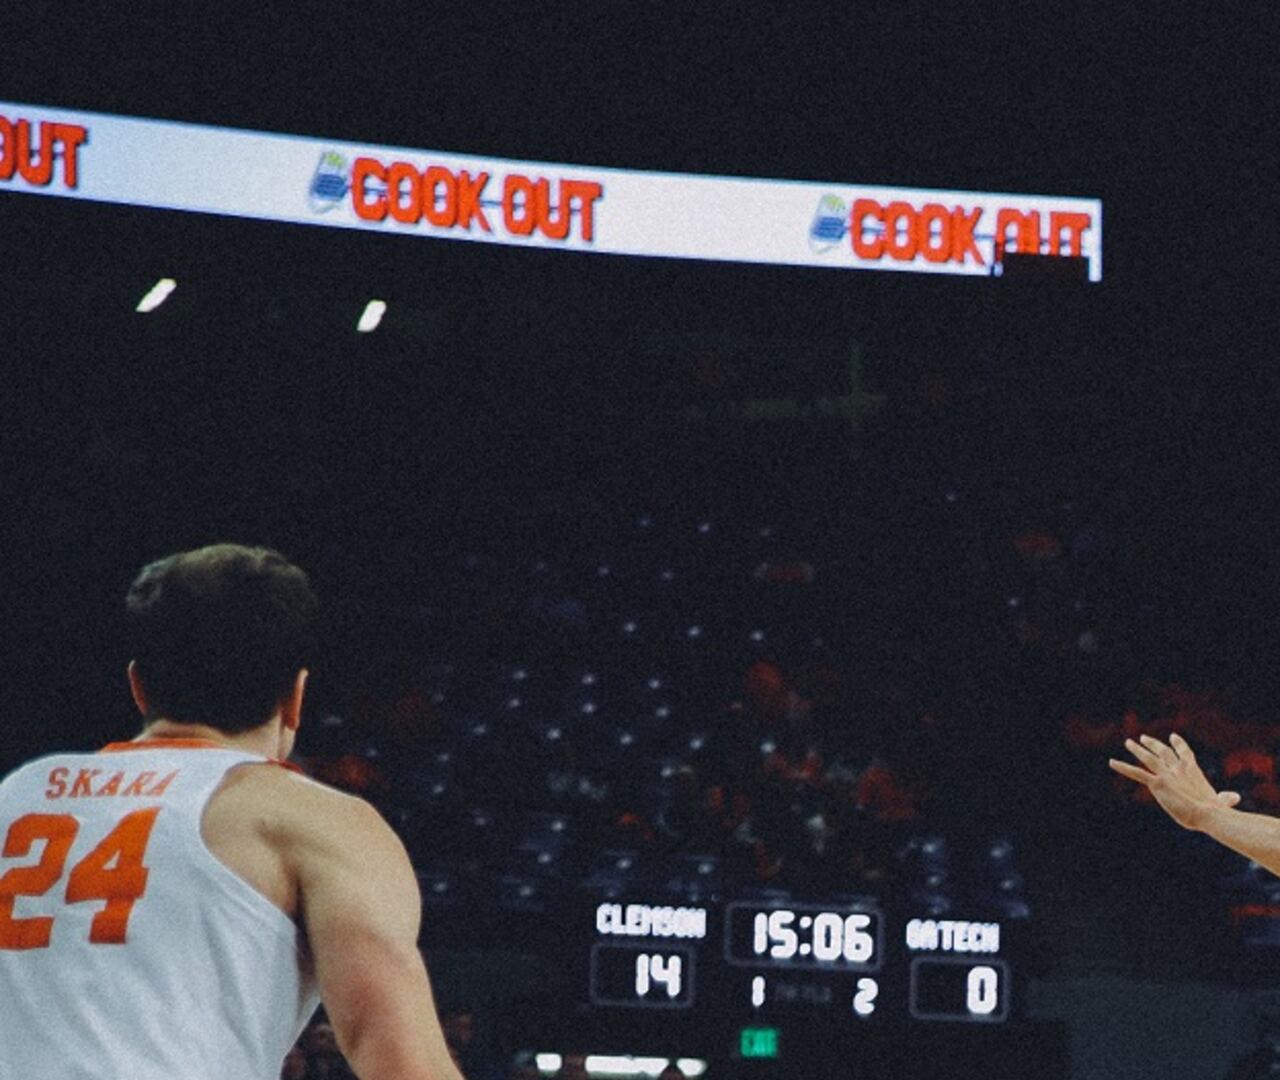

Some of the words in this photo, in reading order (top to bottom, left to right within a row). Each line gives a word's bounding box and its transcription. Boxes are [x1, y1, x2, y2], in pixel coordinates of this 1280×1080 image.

[351, 157, 492, 233] COOK
[502, 174, 603, 242] OUT
[851, 198, 986, 266] COOK
[45, 767, 181, 800] SKARA
[0, 806, 162, 951] 24
[596, 903, 707, 938] CLEMSON
[754, 910, 874, 962] 15:06
[636, 953, 682, 998] 14
[752, 975, 765, 1007] 1
[853, 977, 879, 1015] 2
[967, 965, 998, 1014] 0
